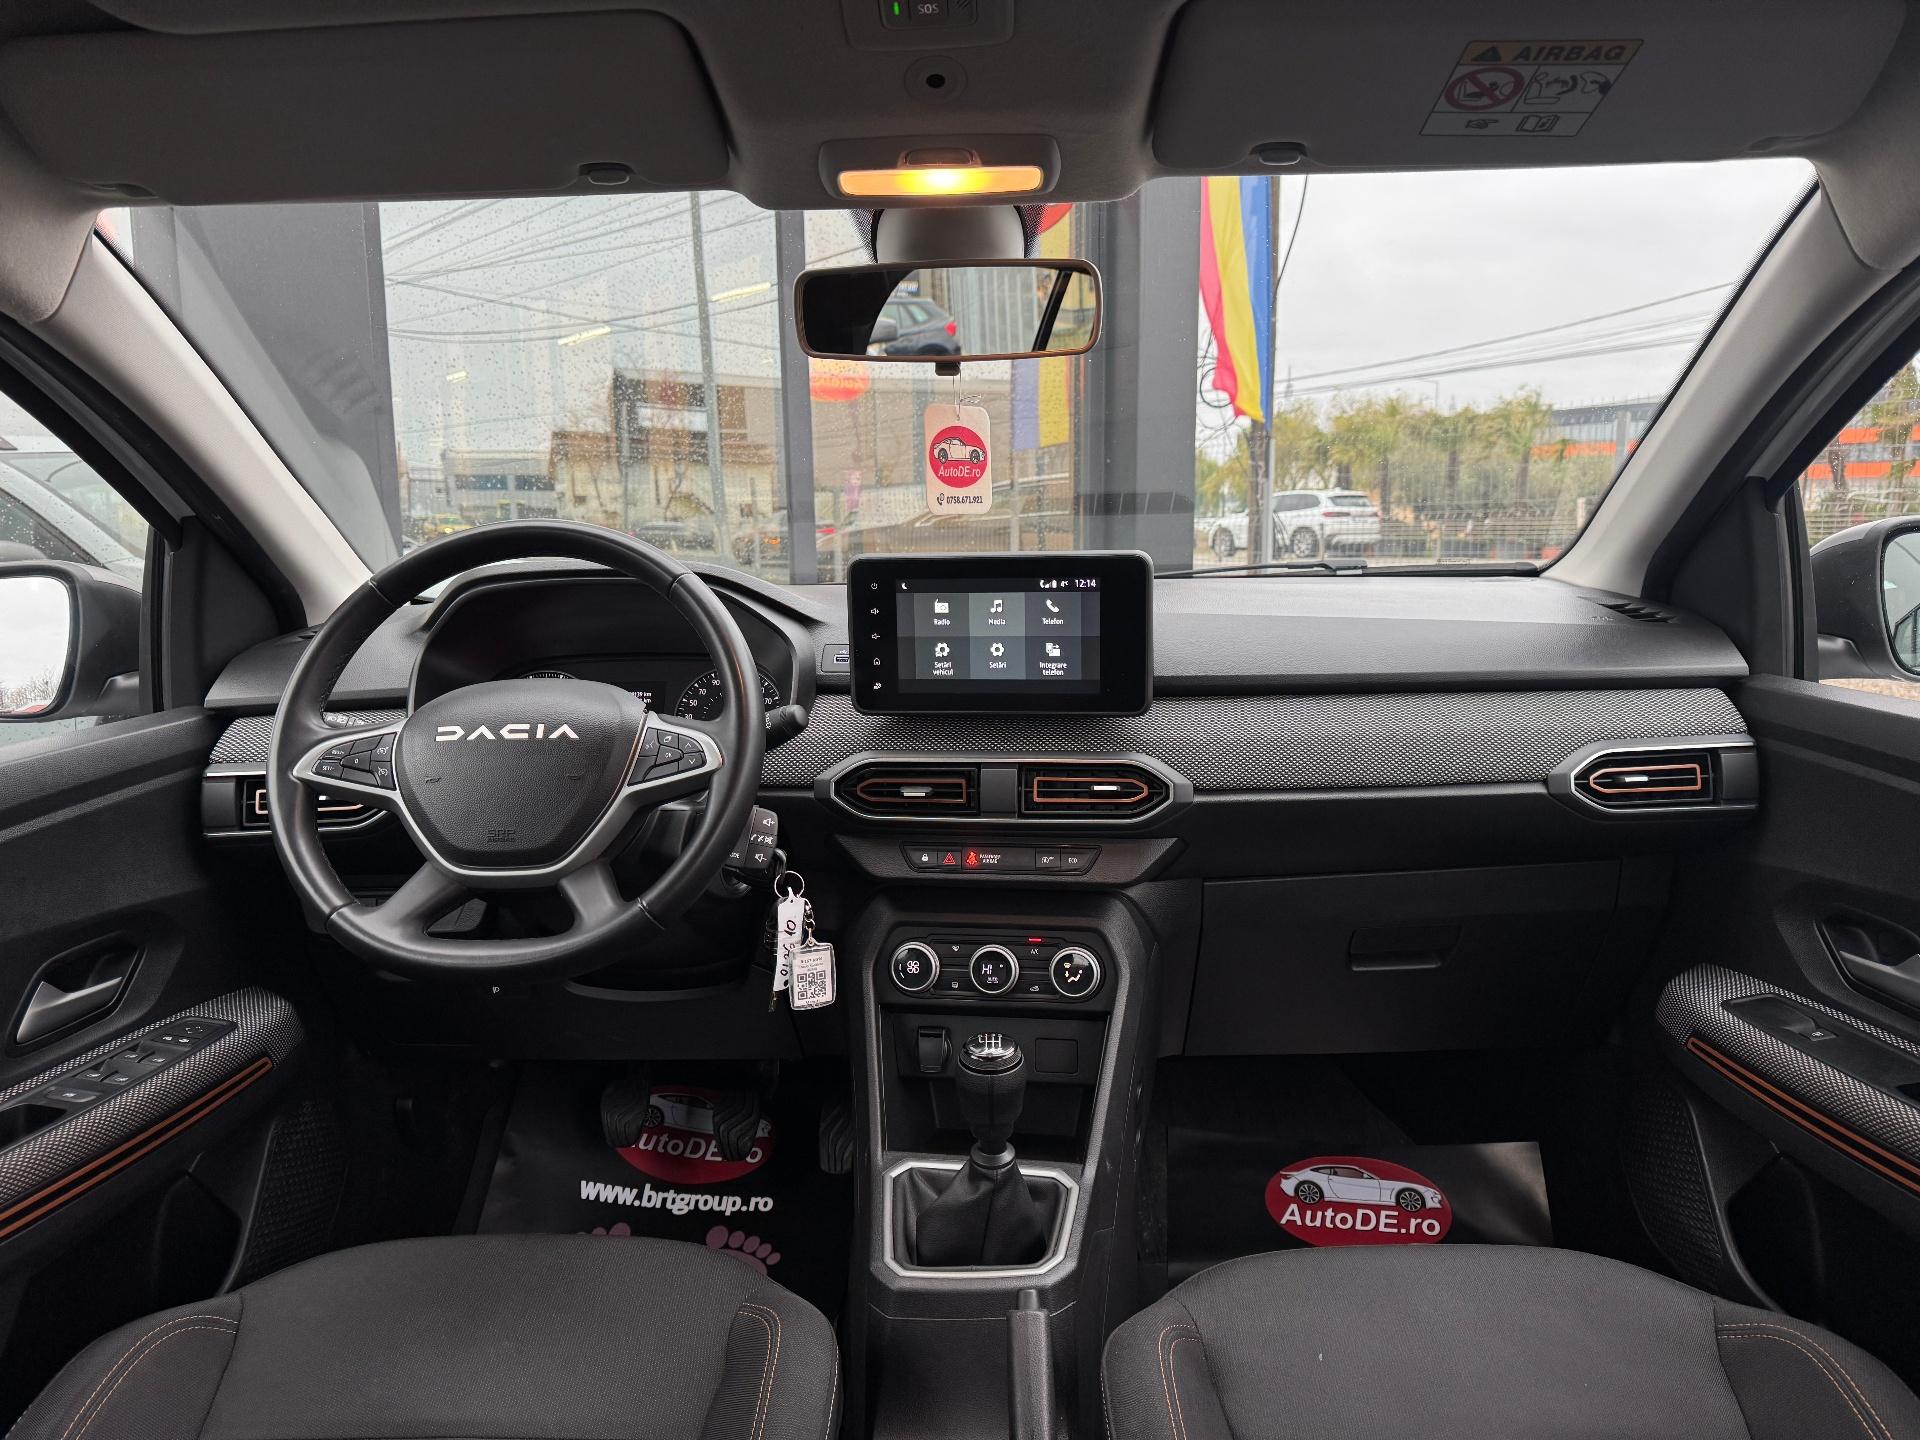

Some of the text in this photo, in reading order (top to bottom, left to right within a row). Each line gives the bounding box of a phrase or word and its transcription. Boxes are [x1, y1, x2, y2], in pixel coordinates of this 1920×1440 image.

[917, 3, 939, 14] SOS
[1512, 45, 1625, 62] AIRBAG
[938, 465, 981, 478] AutoDE.ro
[946, 495, 983, 504] 0758.671.921
[1074, 579, 1096, 588] 12:14
[933, 618, 951, 626] Radio
[1042, 617, 1064, 625] Telefon
[1039, 661, 1067, 670] Integrare
[932, 668, 954, 676] vehicul
[1042, 668, 1064, 676] telefon
[699, 688, 707, 696] 70
[689, 699, 698, 707] 50
[435, 723, 580, 742] DACIA
[580, 1179, 774, 1217] www.brtgroup.ro
[1280, 1203, 1441, 1236] AutoDE.ro
